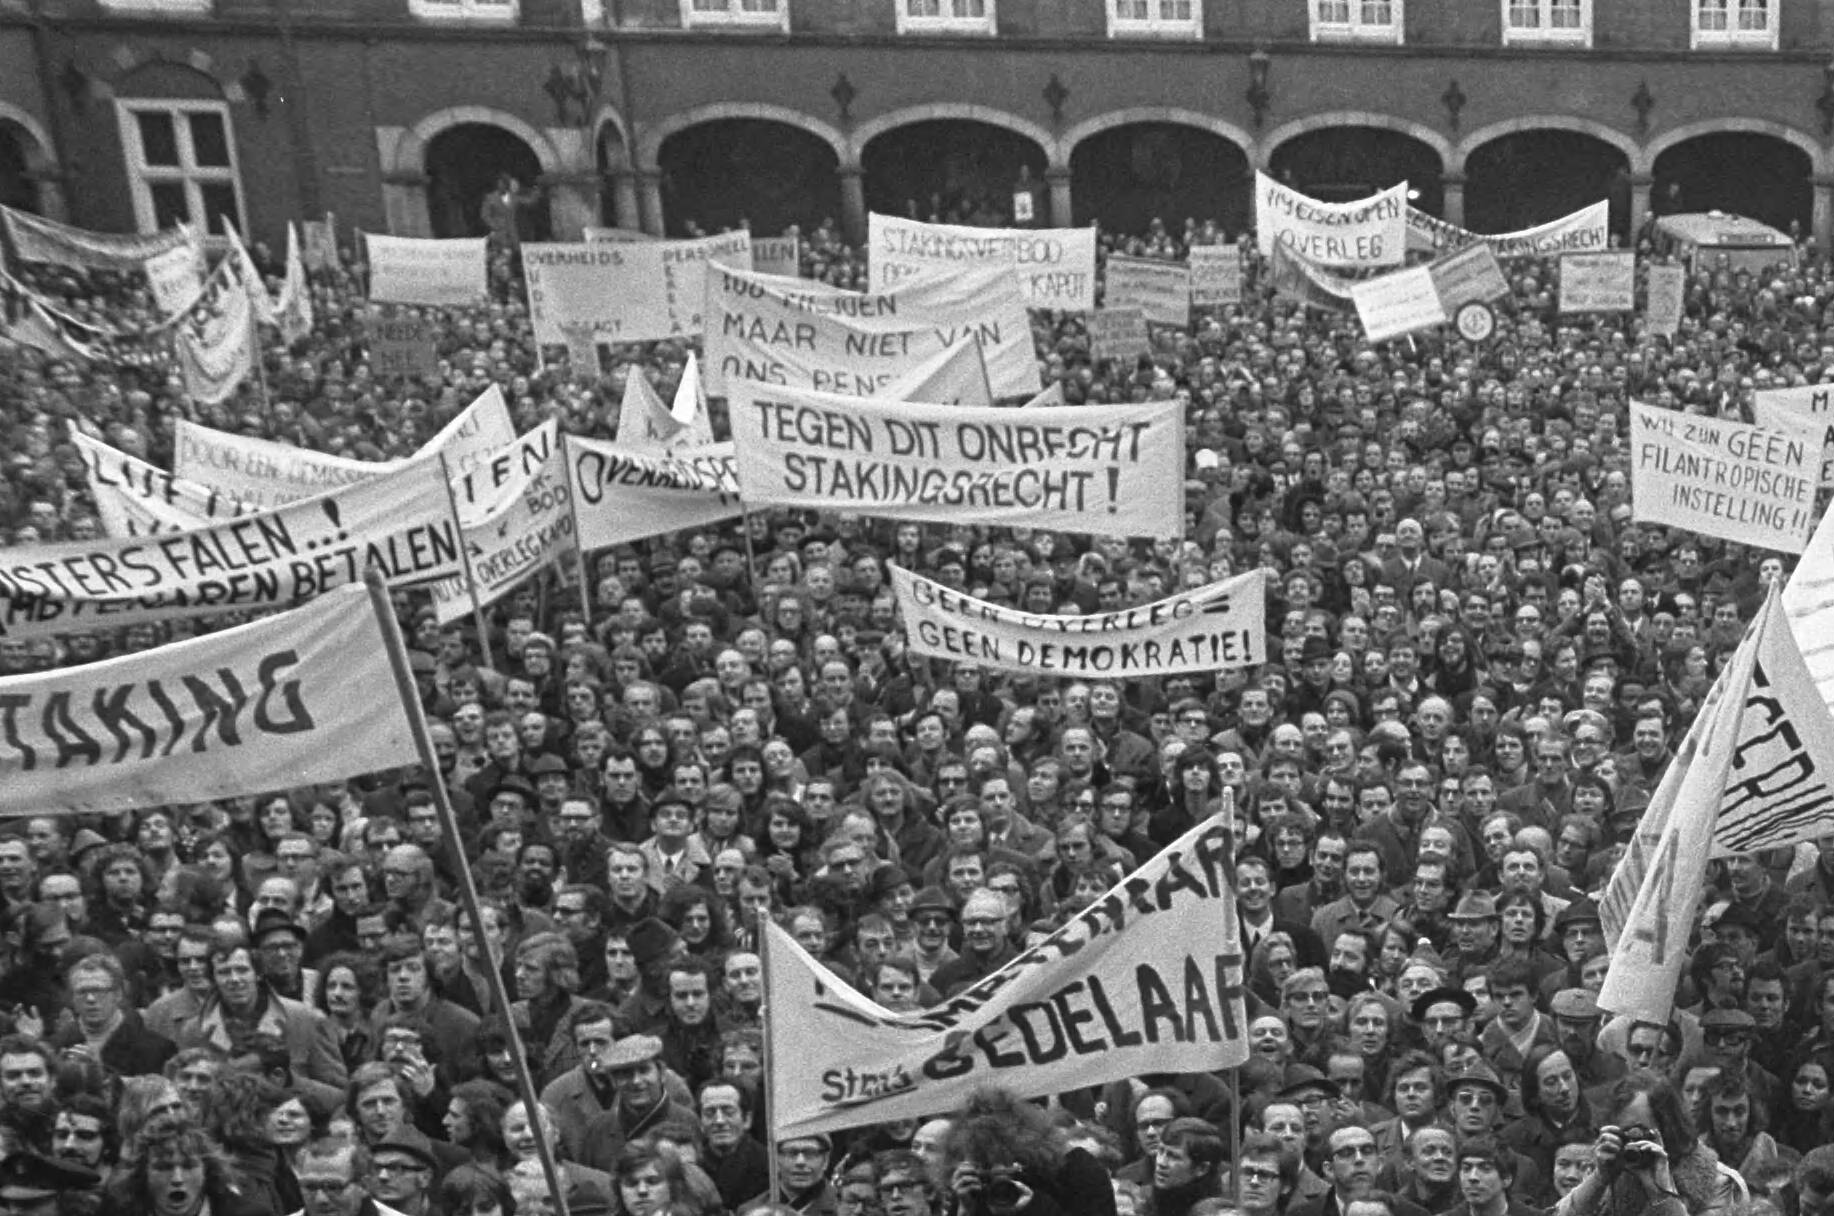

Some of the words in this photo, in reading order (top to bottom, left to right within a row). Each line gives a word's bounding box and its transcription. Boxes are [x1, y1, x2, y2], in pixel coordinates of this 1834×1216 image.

[1279, 229, 1383, 260] OVERLEG
[723, 312, 817, 350] MAAR
[845, 330, 914, 357] NIET
[721, 355, 787, 386] ONS
[752, 399, 874, 453] TEGEN
[885, 417, 943, 459] DIT
[957, 419, 1153, 464] ONRECHT
[782, 451, 1093, 513] STAKINGSRECHT
[1639, 442, 1809, 504] FILANTROPISCHE
[527, 484, 569, 515] BOD
[158, 512, 299, 580] FALEN
[291, 519, 459, 598] BETALEN
[912, 580, 999, 622] GEEN
[918, 619, 1002, 662] GEEN
[1016, 629, 1253, 671] DEMOKRATIE!
